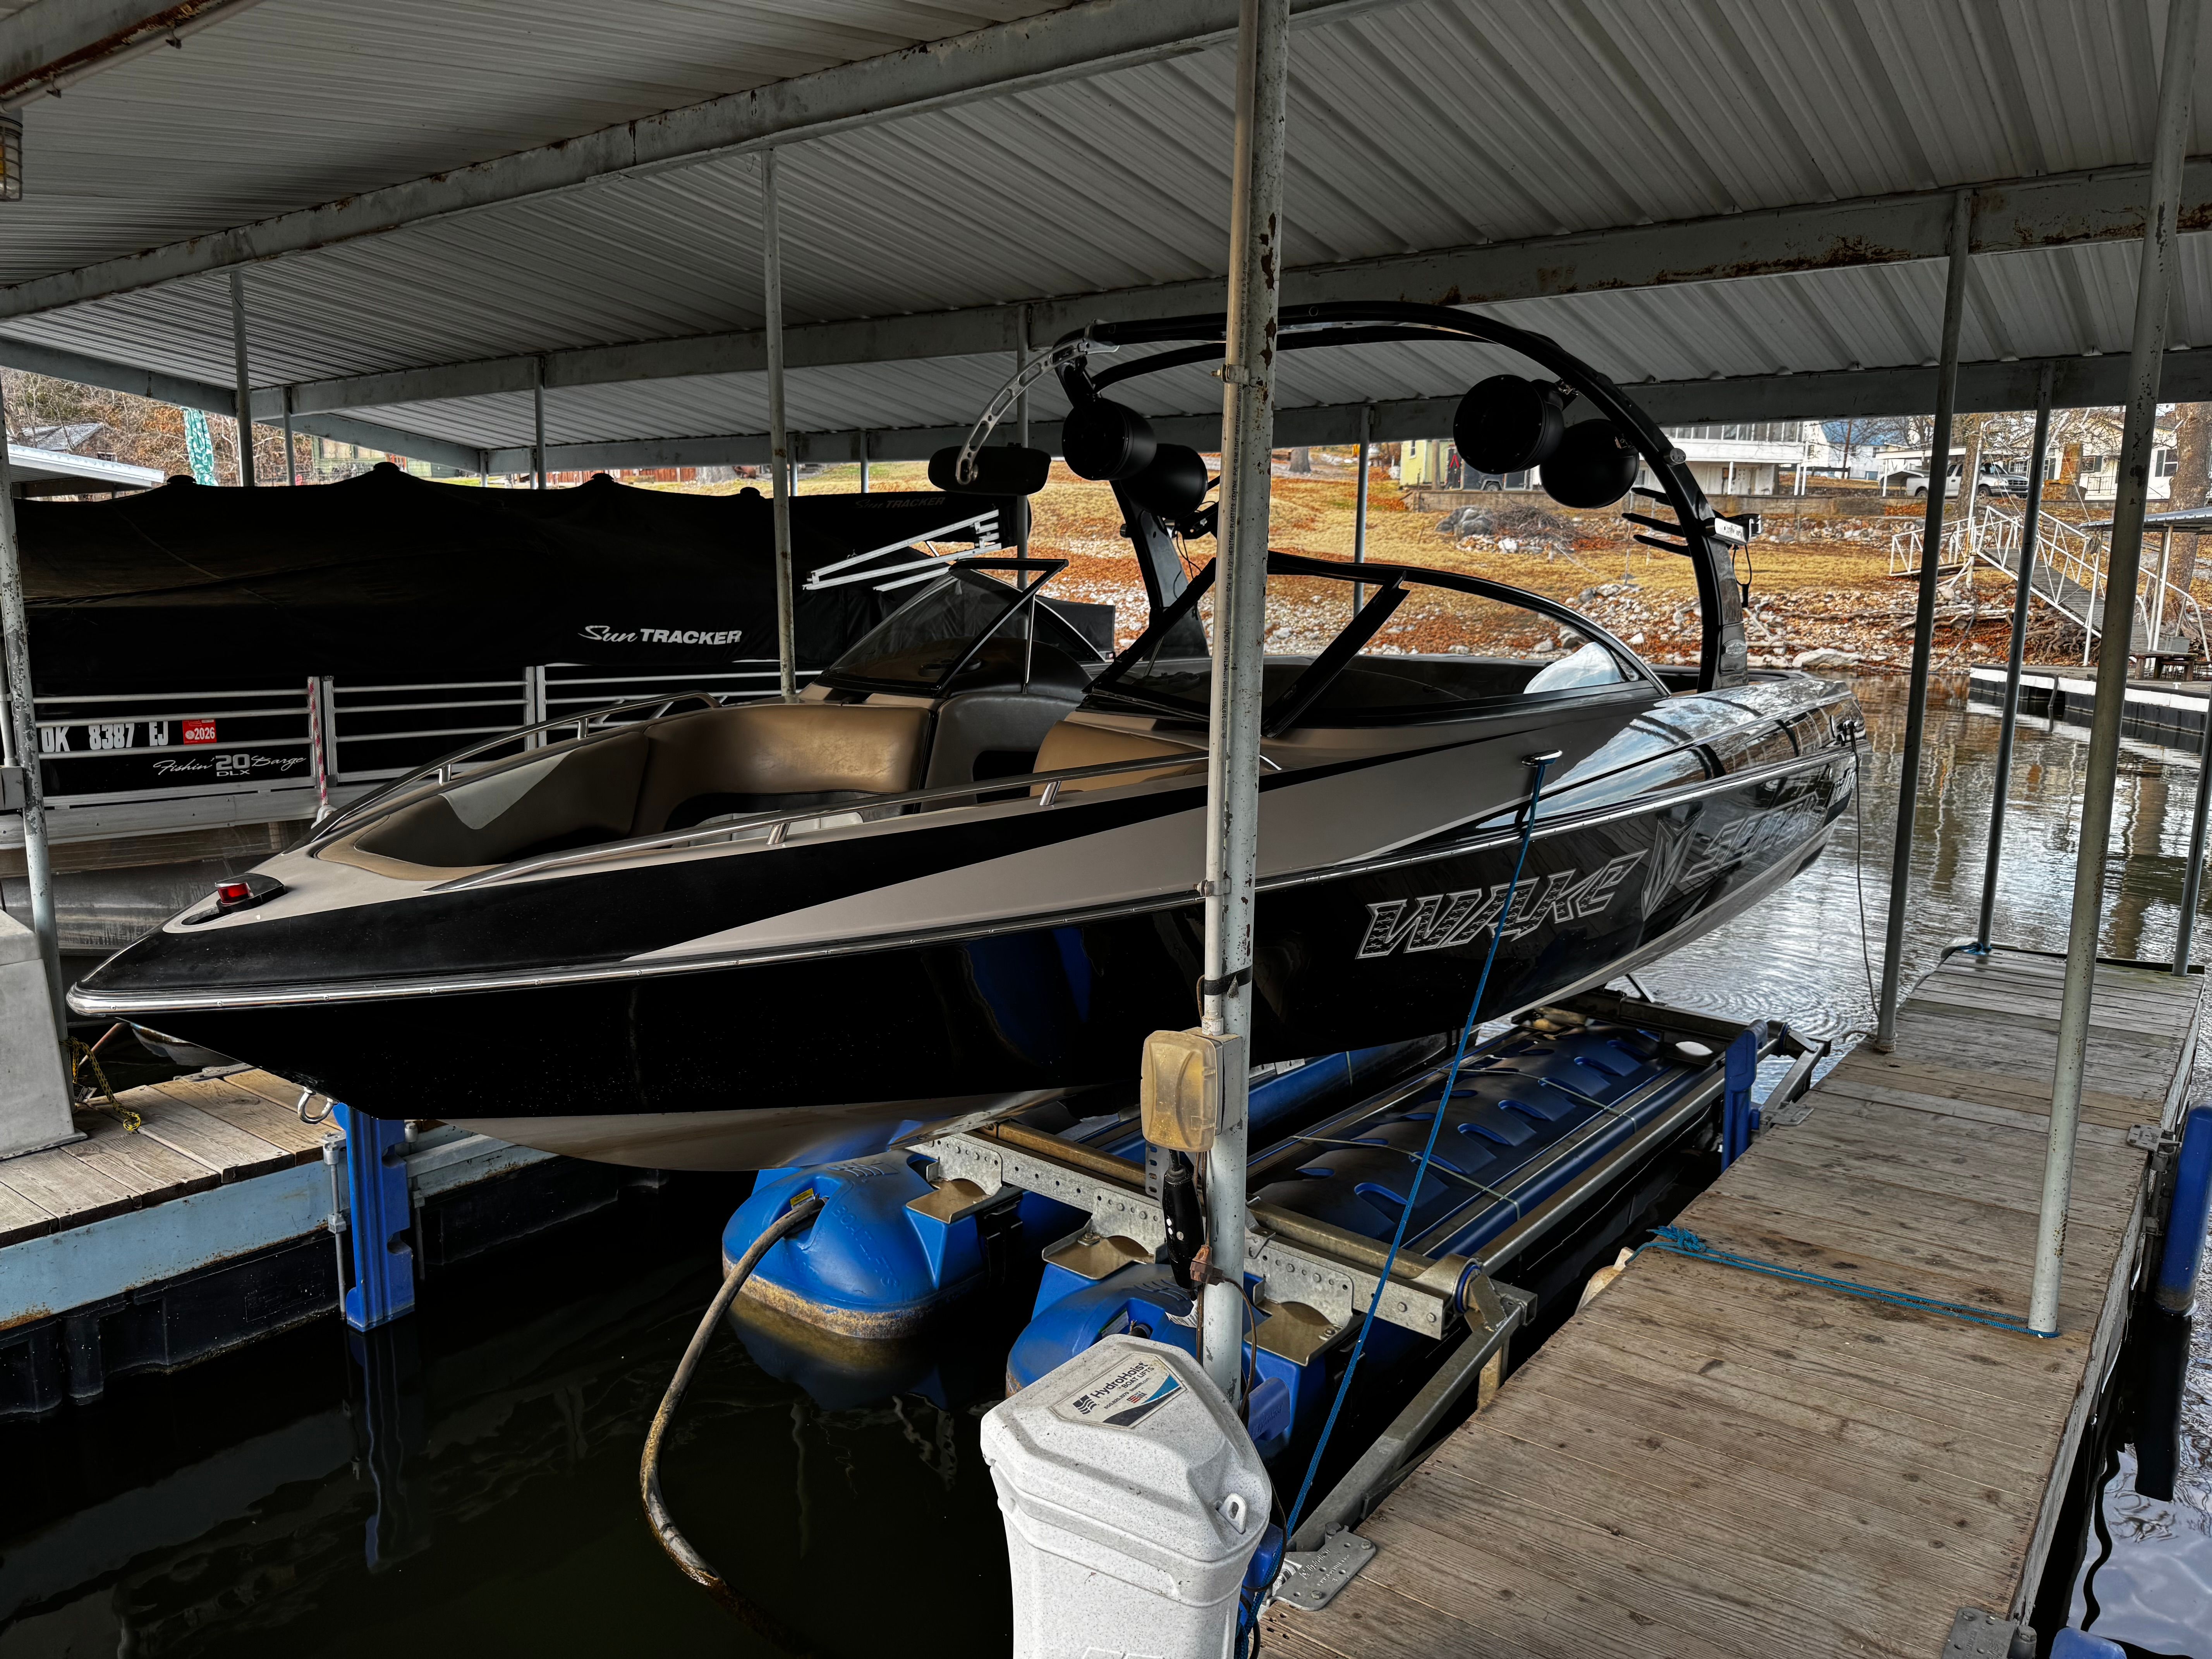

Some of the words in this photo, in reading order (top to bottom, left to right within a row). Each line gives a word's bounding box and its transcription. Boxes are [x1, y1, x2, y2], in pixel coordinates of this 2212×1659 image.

[886, 496, 946, 508] TRACKER
[577, 625, 638, 642] Sun
[640, 628, 742, 645] TRACKER
[88, 722, 135, 750] 8387
[194, 726, 215, 740] 2026
[215, 754, 250, 771] 20
[251, 755, 307, 771] Barge
[1090, 1361, 1149, 1398] HydroHoist
[1121, 1376, 1139, 1388] BOAT
[1137, 1366, 1155, 1378] LIFTS
